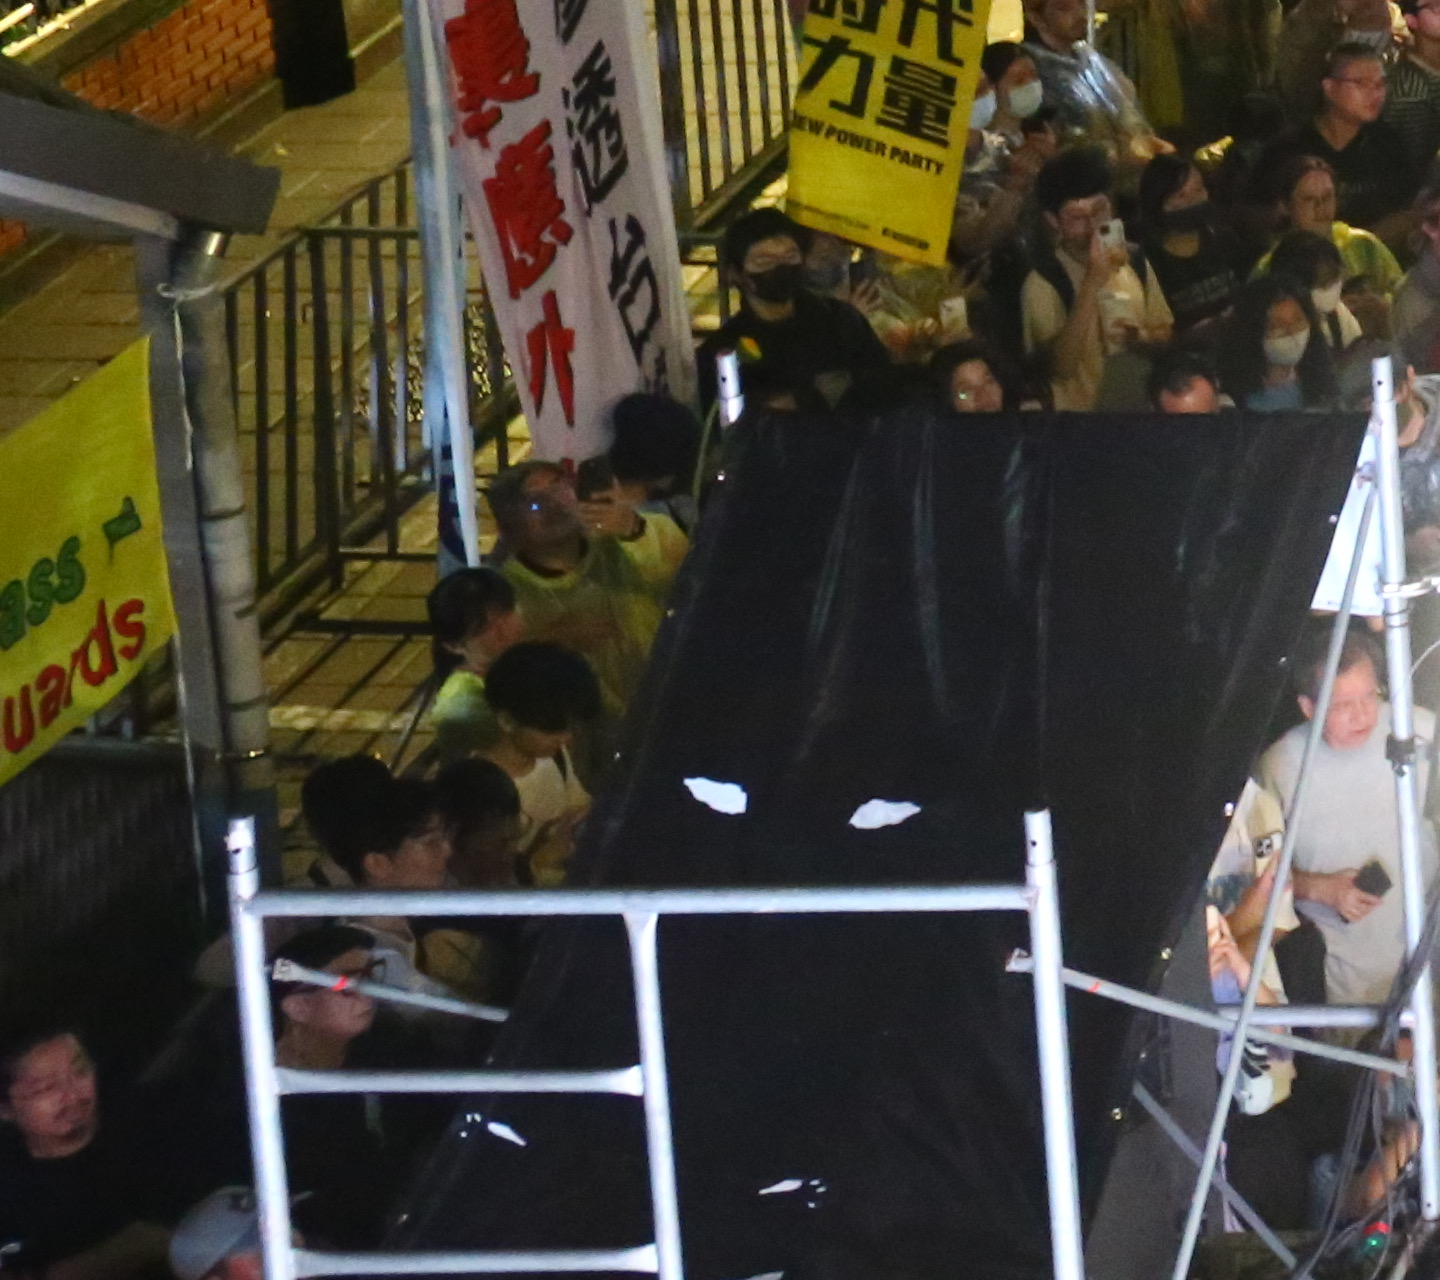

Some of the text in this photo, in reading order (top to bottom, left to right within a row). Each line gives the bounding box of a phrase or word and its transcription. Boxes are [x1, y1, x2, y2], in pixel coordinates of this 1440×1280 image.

[799, 34, 957, 150] 力量
[824, 122, 887, 157] POWER
[888, 146, 945, 177] PARTY
